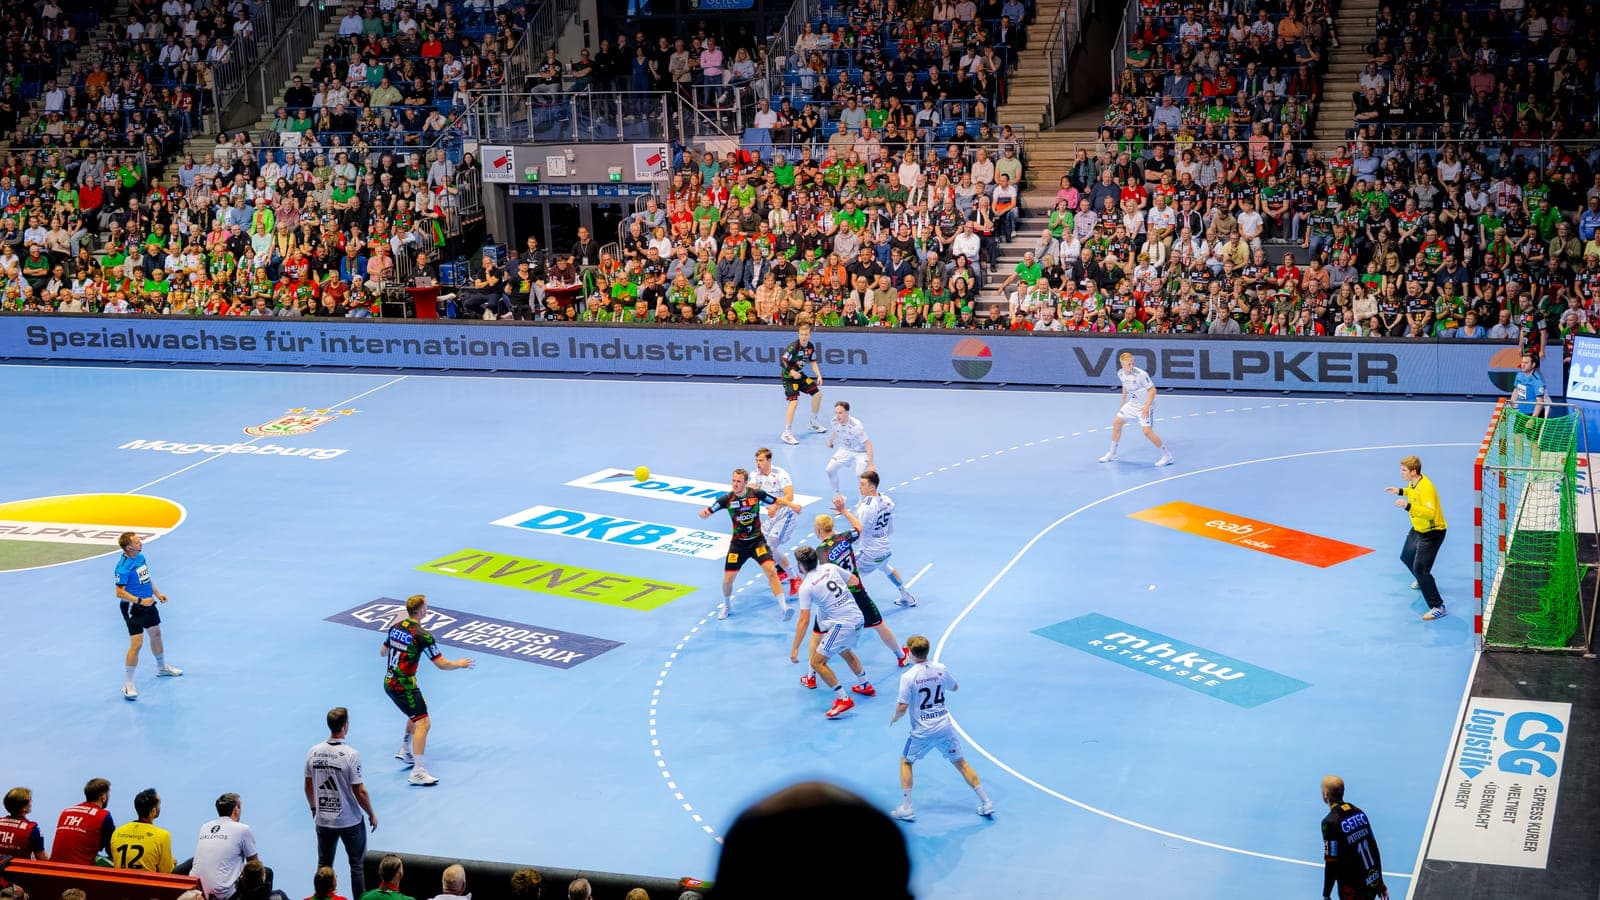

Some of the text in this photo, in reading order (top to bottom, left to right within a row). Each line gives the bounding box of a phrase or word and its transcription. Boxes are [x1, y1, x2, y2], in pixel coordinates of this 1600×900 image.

[26, 325, 868, 365] Spezialwachse für internationale Industriekuen
[117, 439, 349, 459] Magdeburg
[516, 509, 678, 546] DKB
[874, 512, 891, 531] 55
[1205, 520, 1253, 535] eab
[656, 544, 700, 555] Bank
[672, 537, 714, 549] kann
[688, 531, 720, 541] Das
[828, 540, 850, 561] GETEC
[432, 553, 675, 603] AVNET
[826, 580, 843, 599] 9
[442, 628, 585, 664] WEAR HAIX
[459, 620, 560, 646] HEROES
[1088, 639, 1221, 687] ROTHENSEE
[1104, 631, 1246, 680] mhkw
[918, 684, 946, 711] 24
[1459, 708, 1505, 770] Logistik
[1497, 711, 1565, 778] CSG
[1454, 781, 1473, 809] DIREKT
[1475, 783, 1500, 830] ÜBERNACHT
[1502, 785, 1522, 824] WELTWEIT
[1341, 813, 1369, 833] GETEC
[1523, 786, 1548, 853] EXPRESS KURIER
[116, 844, 146, 869] 12
[1357, 839, 1375, 871] 11
